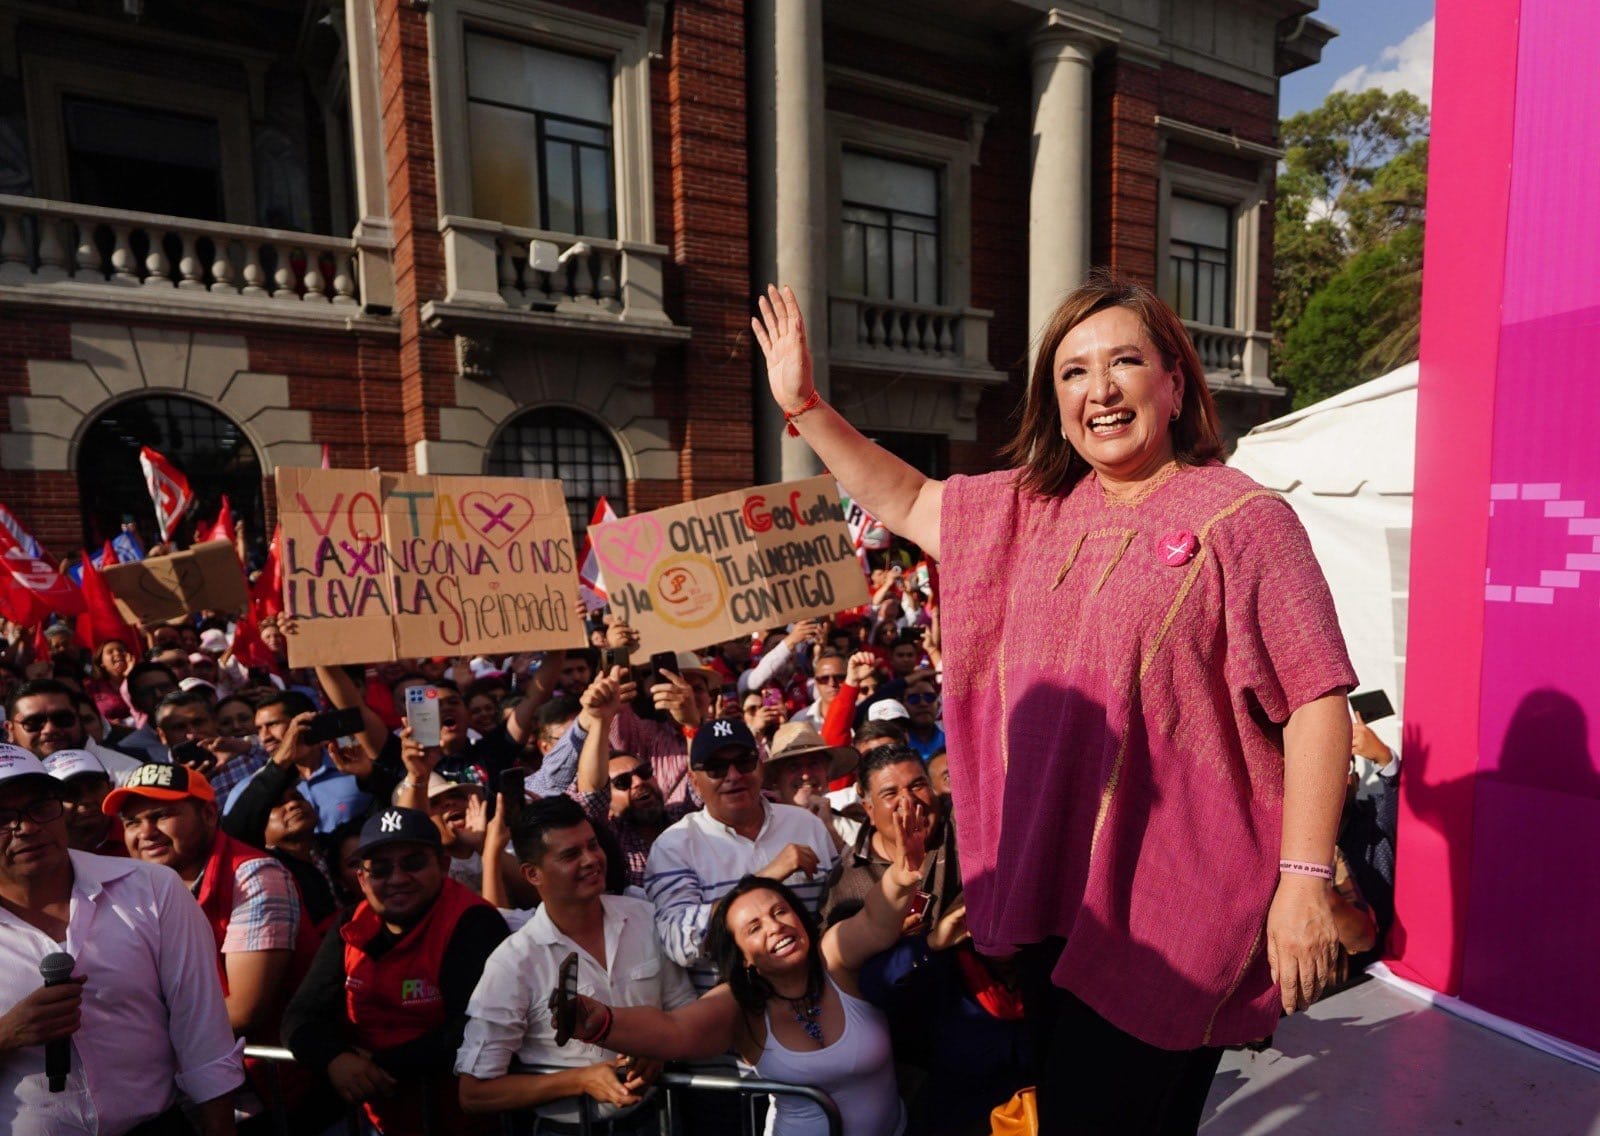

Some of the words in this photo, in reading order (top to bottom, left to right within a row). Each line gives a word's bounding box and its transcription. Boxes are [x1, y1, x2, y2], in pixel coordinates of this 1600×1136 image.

[295, 490, 467, 542] VOTA
[508, 543, 524, 574] O
[529, 538, 573, 575] NOS
[436, 575, 568, 646] Sheingada
[730, 569, 835, 625] CONTIGO
[381, 811, 402, 832] NY
